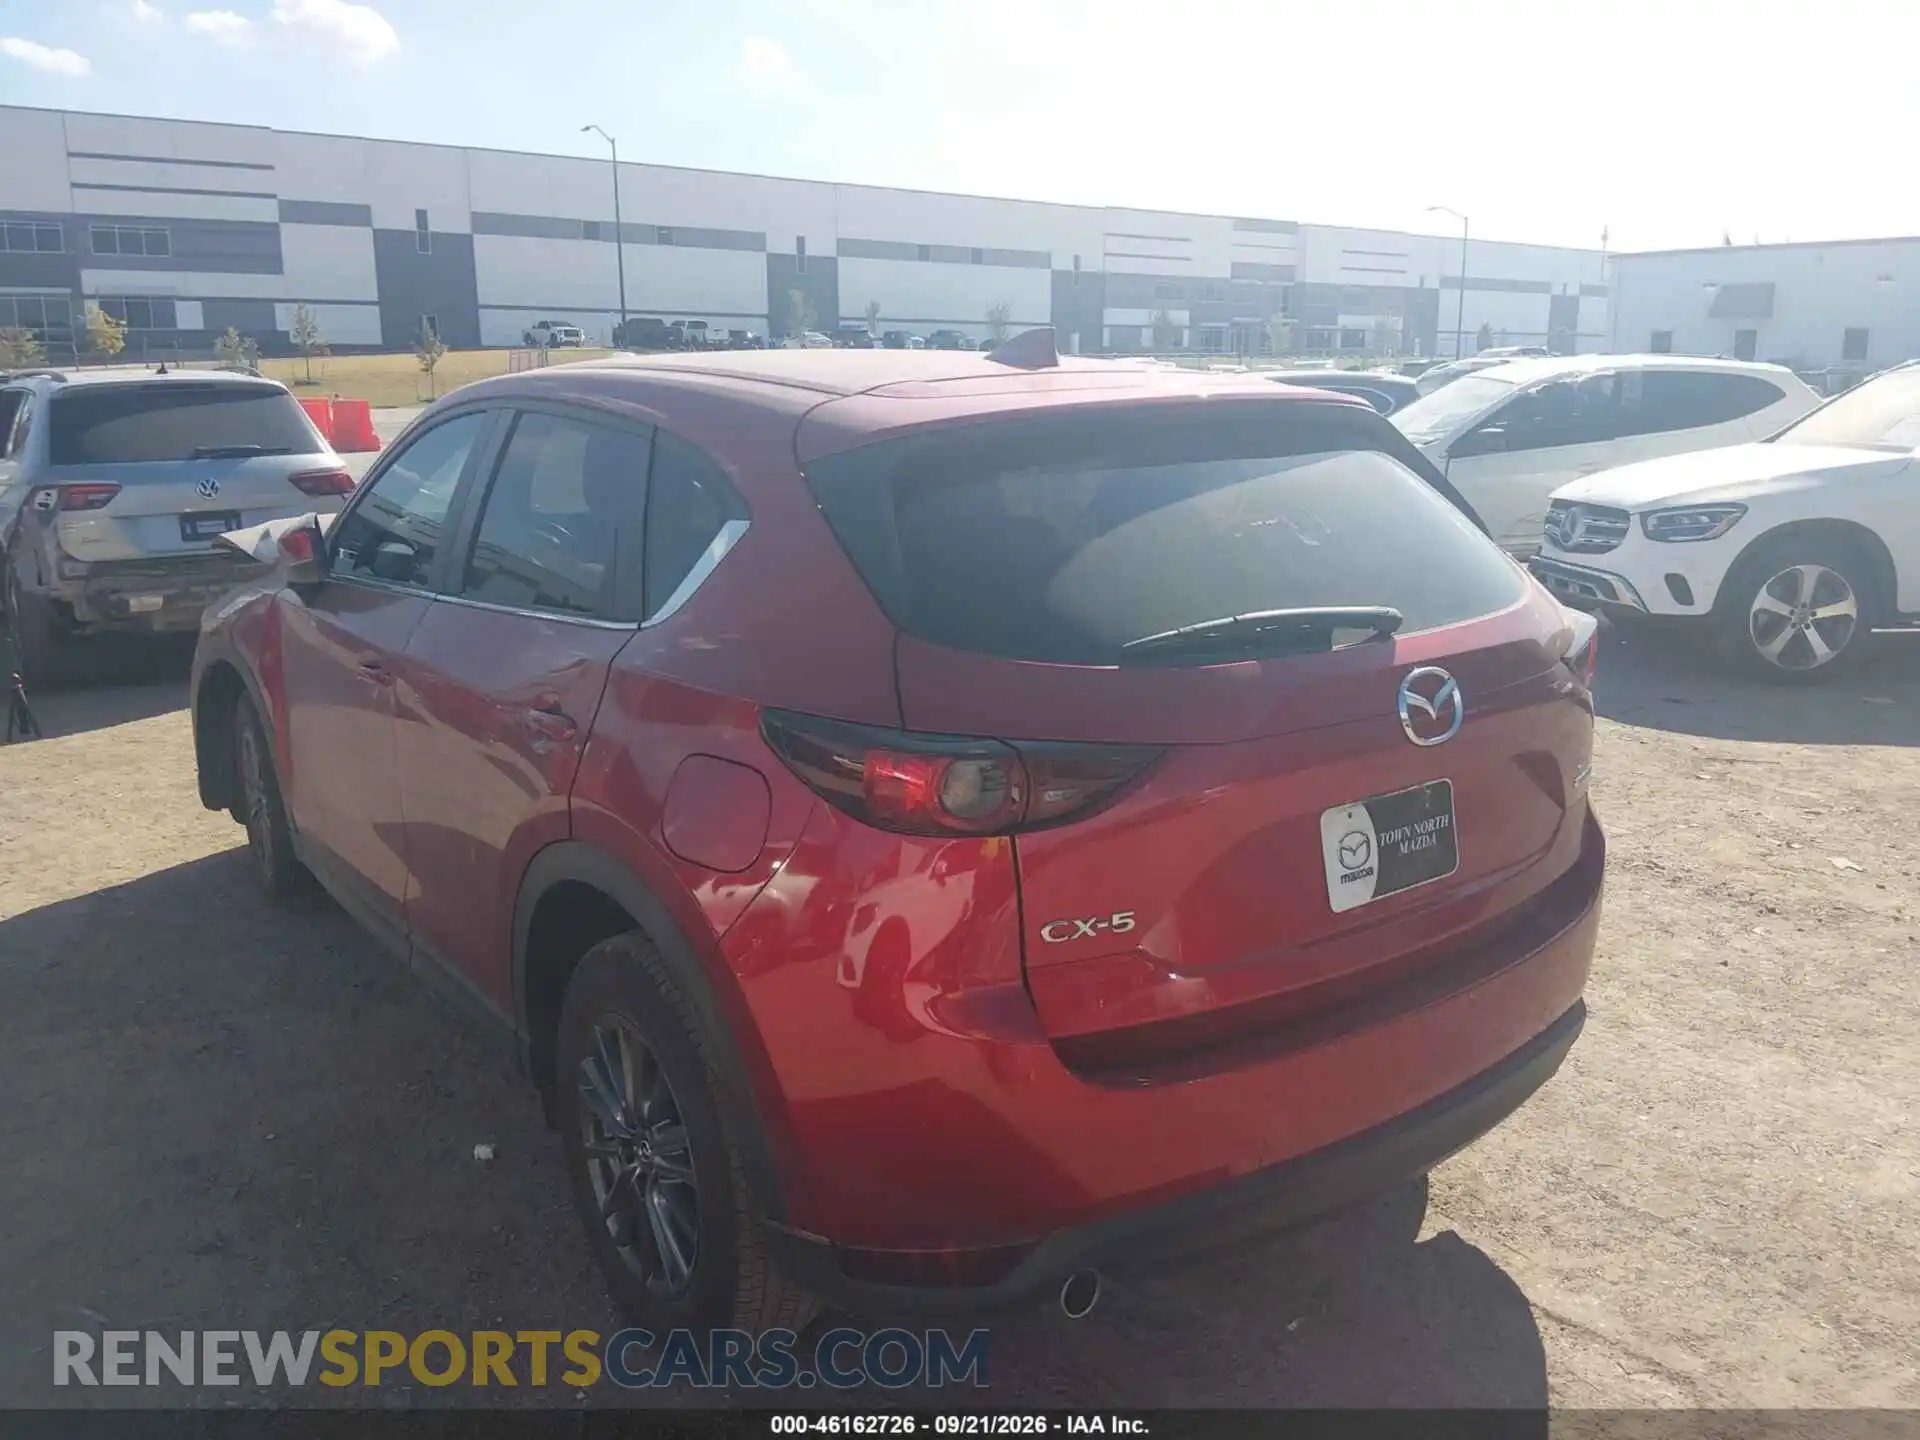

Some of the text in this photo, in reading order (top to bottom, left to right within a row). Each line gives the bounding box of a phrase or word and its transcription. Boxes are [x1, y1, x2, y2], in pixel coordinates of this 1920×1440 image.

[1379, 814, 1450, 847] TOWN NORTH
[1400, 832, 1437, 855] MAZDA
[1040, 911, 1136, 943] CX-5
